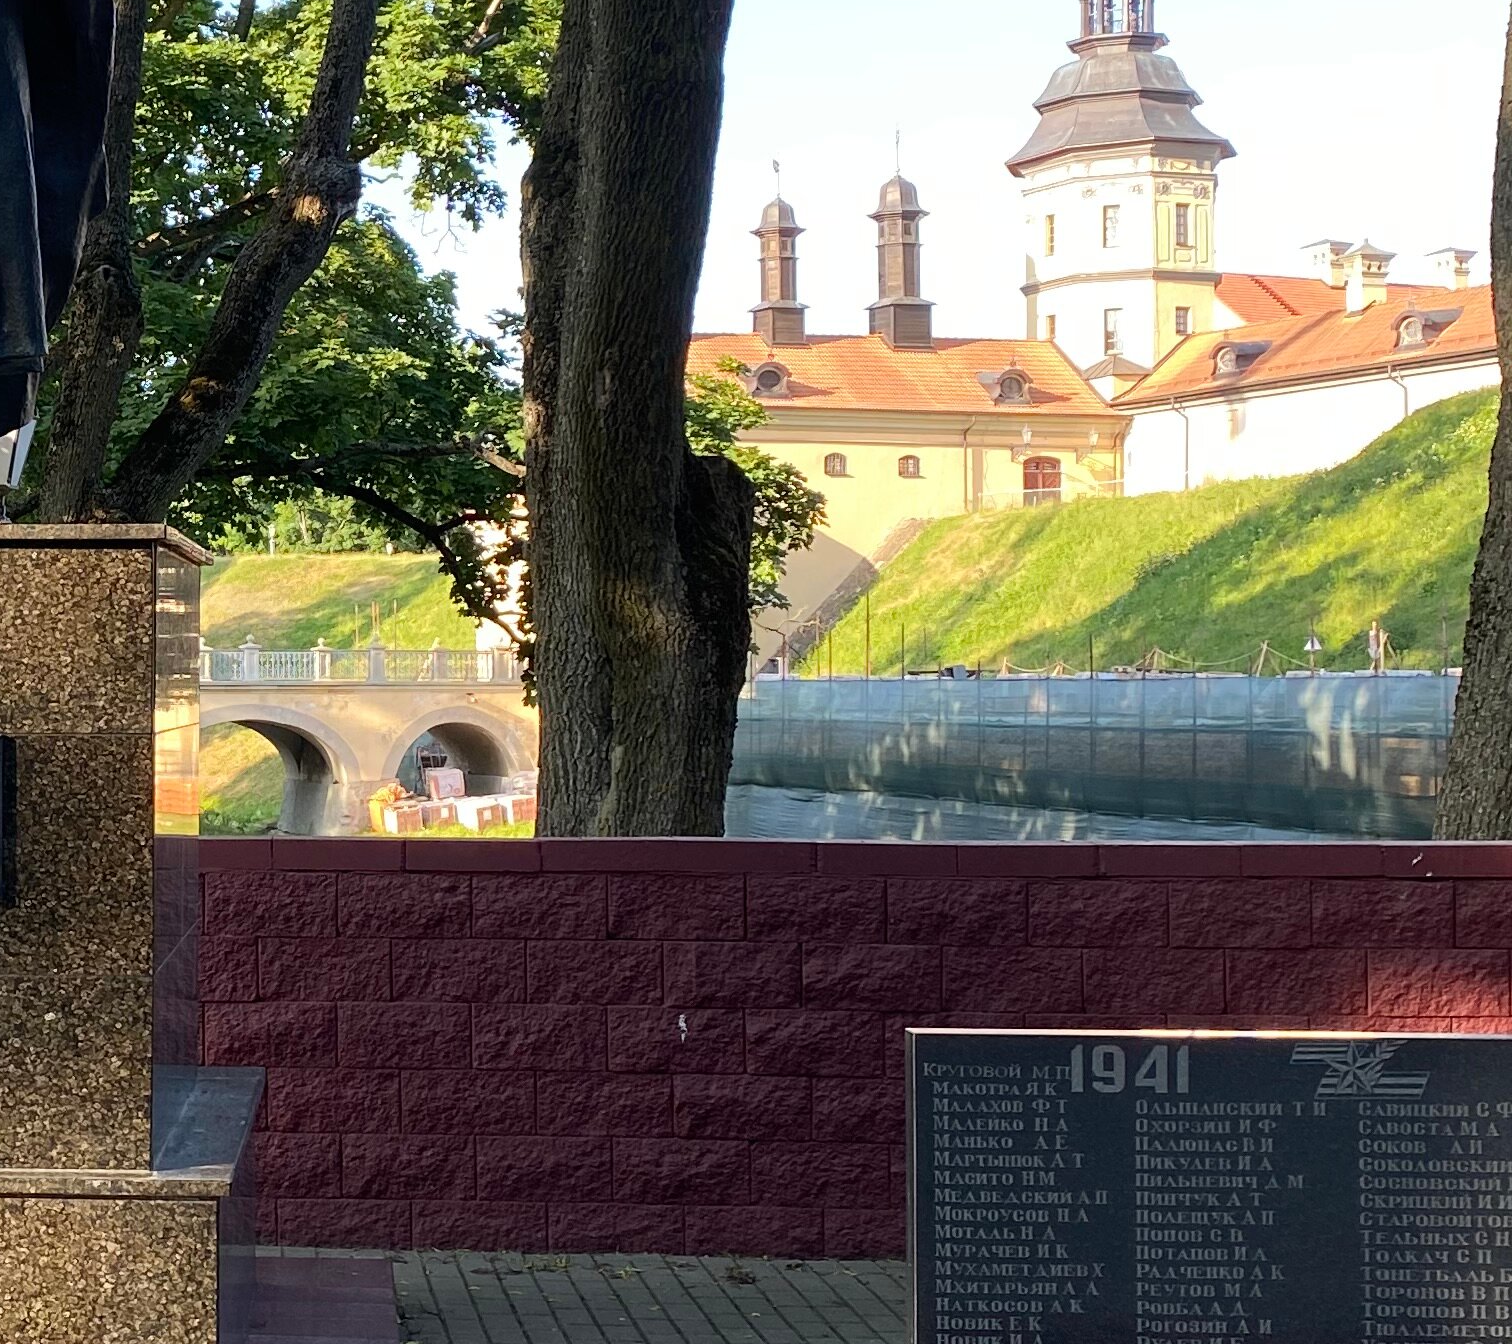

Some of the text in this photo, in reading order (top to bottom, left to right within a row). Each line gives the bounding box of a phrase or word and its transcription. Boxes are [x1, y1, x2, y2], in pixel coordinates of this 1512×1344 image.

[924, 1063, 1021, 1078] КРУГОВОЙ
[1071, 1045, 1188, 1094] 1941
[1025, 1082, 1038, 1095] Я
[1045, 1083, 1056, 1095] К
[1032, 1099, 1050, 1113] Ф
[1056, 1100, 1068, 1113] Т
[1293, 1102, 1304, 1116] Т
[1477, 1102, 1489, 1117] С
[1056, 1118, 1068, 1131] А
[1258, 1119, 1276, 1133] Ф
[1460, 1121, 1478, 1136] М
[1486, 1123, 1499, 1136] А
[934, 1134, 1068, 1149] МАНЬКО А Е
[1051, 1153, 1064, 1168] А
[1072, 1153, 1084, 1168] Т
[1039, 1171, 1055, 1185] М
[1288, 1175, 1303, 1188] М
[1077, 1191, 1091, 1204] А
[1226, 1193, 1241, 1206] А
[1249, 1193, 1264, 1206] Т
[1078, 1208, 1088, 1222] А
[1241, 1210, 1255, 1224] А
[1043, 1226, 1055, 1240] А
[1210, 1229, 1221, 1242] С
[1475, 1231, 1488, 1245] С
[1038, 1244, 1050, 1258] И
[1056, 1244, 1068, 1258] К
[1457, 1249, 1469, 1263] С
[1092, 1263, 1104, 1277] Х
[1250, 1265, 1264, 1280] А
[1272, 1265, 1284, 1279] К
[1225, 1283, 1240, 1297] М
[1472, 1286, 1486, 1300] В
[1050, 1299, 1063, 1313] А
[1070, 1299, 1084, 1313] К
[1495, 1305, 1509, 1319] В
[936, 1316, 1041, 1331] НОВИК Е К
